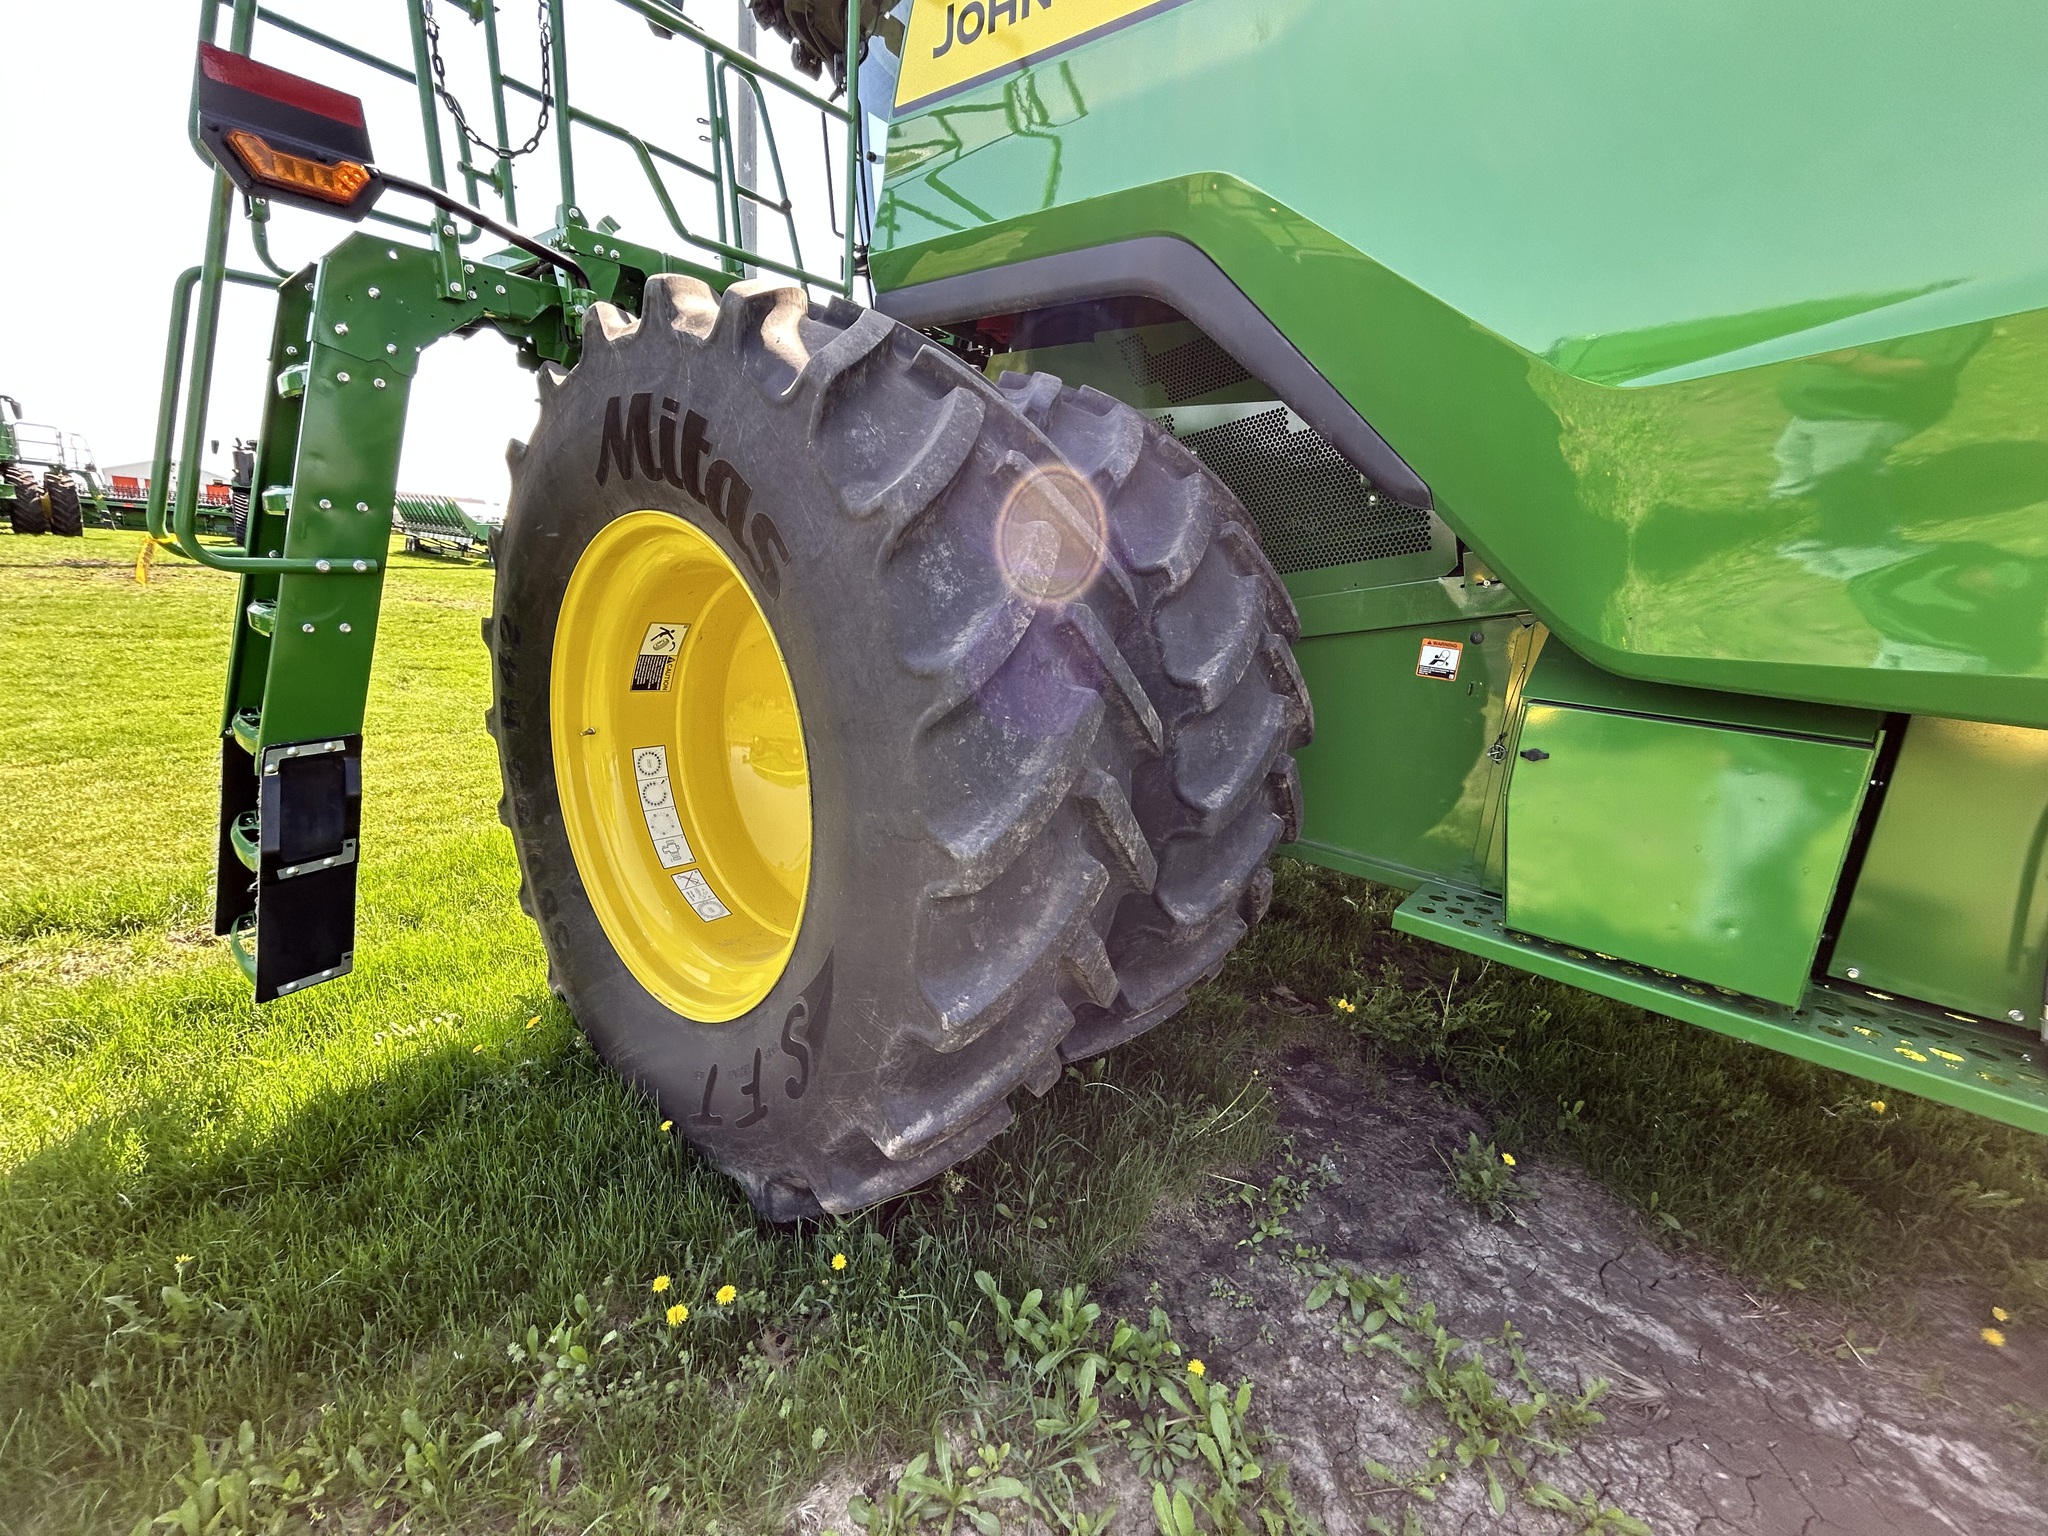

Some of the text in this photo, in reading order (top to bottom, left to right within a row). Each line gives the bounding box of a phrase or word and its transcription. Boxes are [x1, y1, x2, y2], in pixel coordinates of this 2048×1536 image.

[595, 392, 792, 601] Mitas
[661, 663, 673, 691] CAUTION
[1433, 640, 1458, 648] WARNING
[687, 997, 813, 1129] SFT
